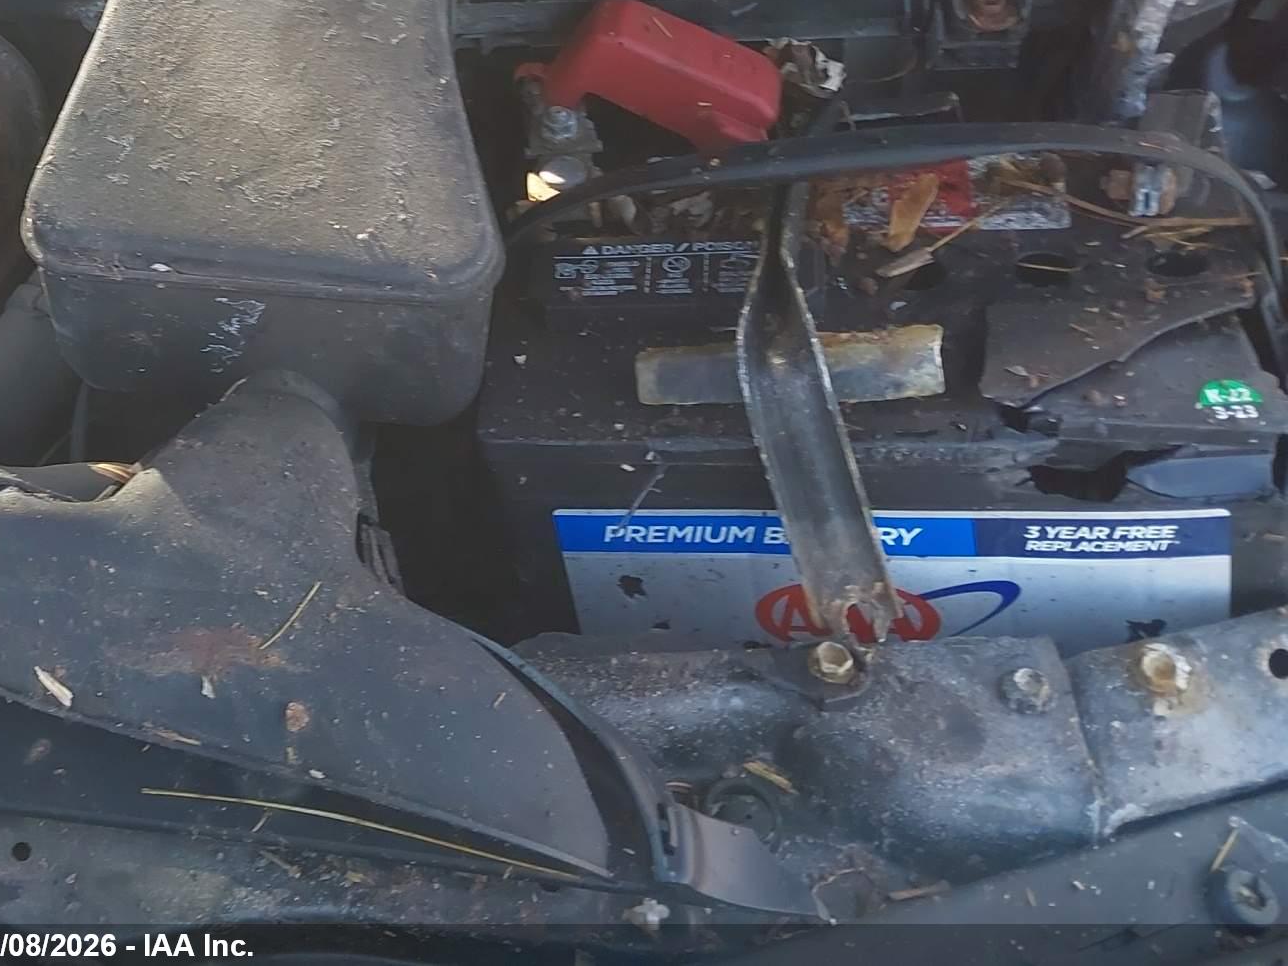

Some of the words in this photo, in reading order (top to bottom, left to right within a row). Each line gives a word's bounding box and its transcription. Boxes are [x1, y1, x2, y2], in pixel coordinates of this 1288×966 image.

[601, 243, 674, 256] DANGER
[604, 525, 755, 544] PREMIUM
[1024, 526, 1042, 539] 3
[1044, 526, 1111, 540] YEAR
[1113, 525, 1179, 539] FREE
[1024, 540, 1171, 552] REPLACEMENT
